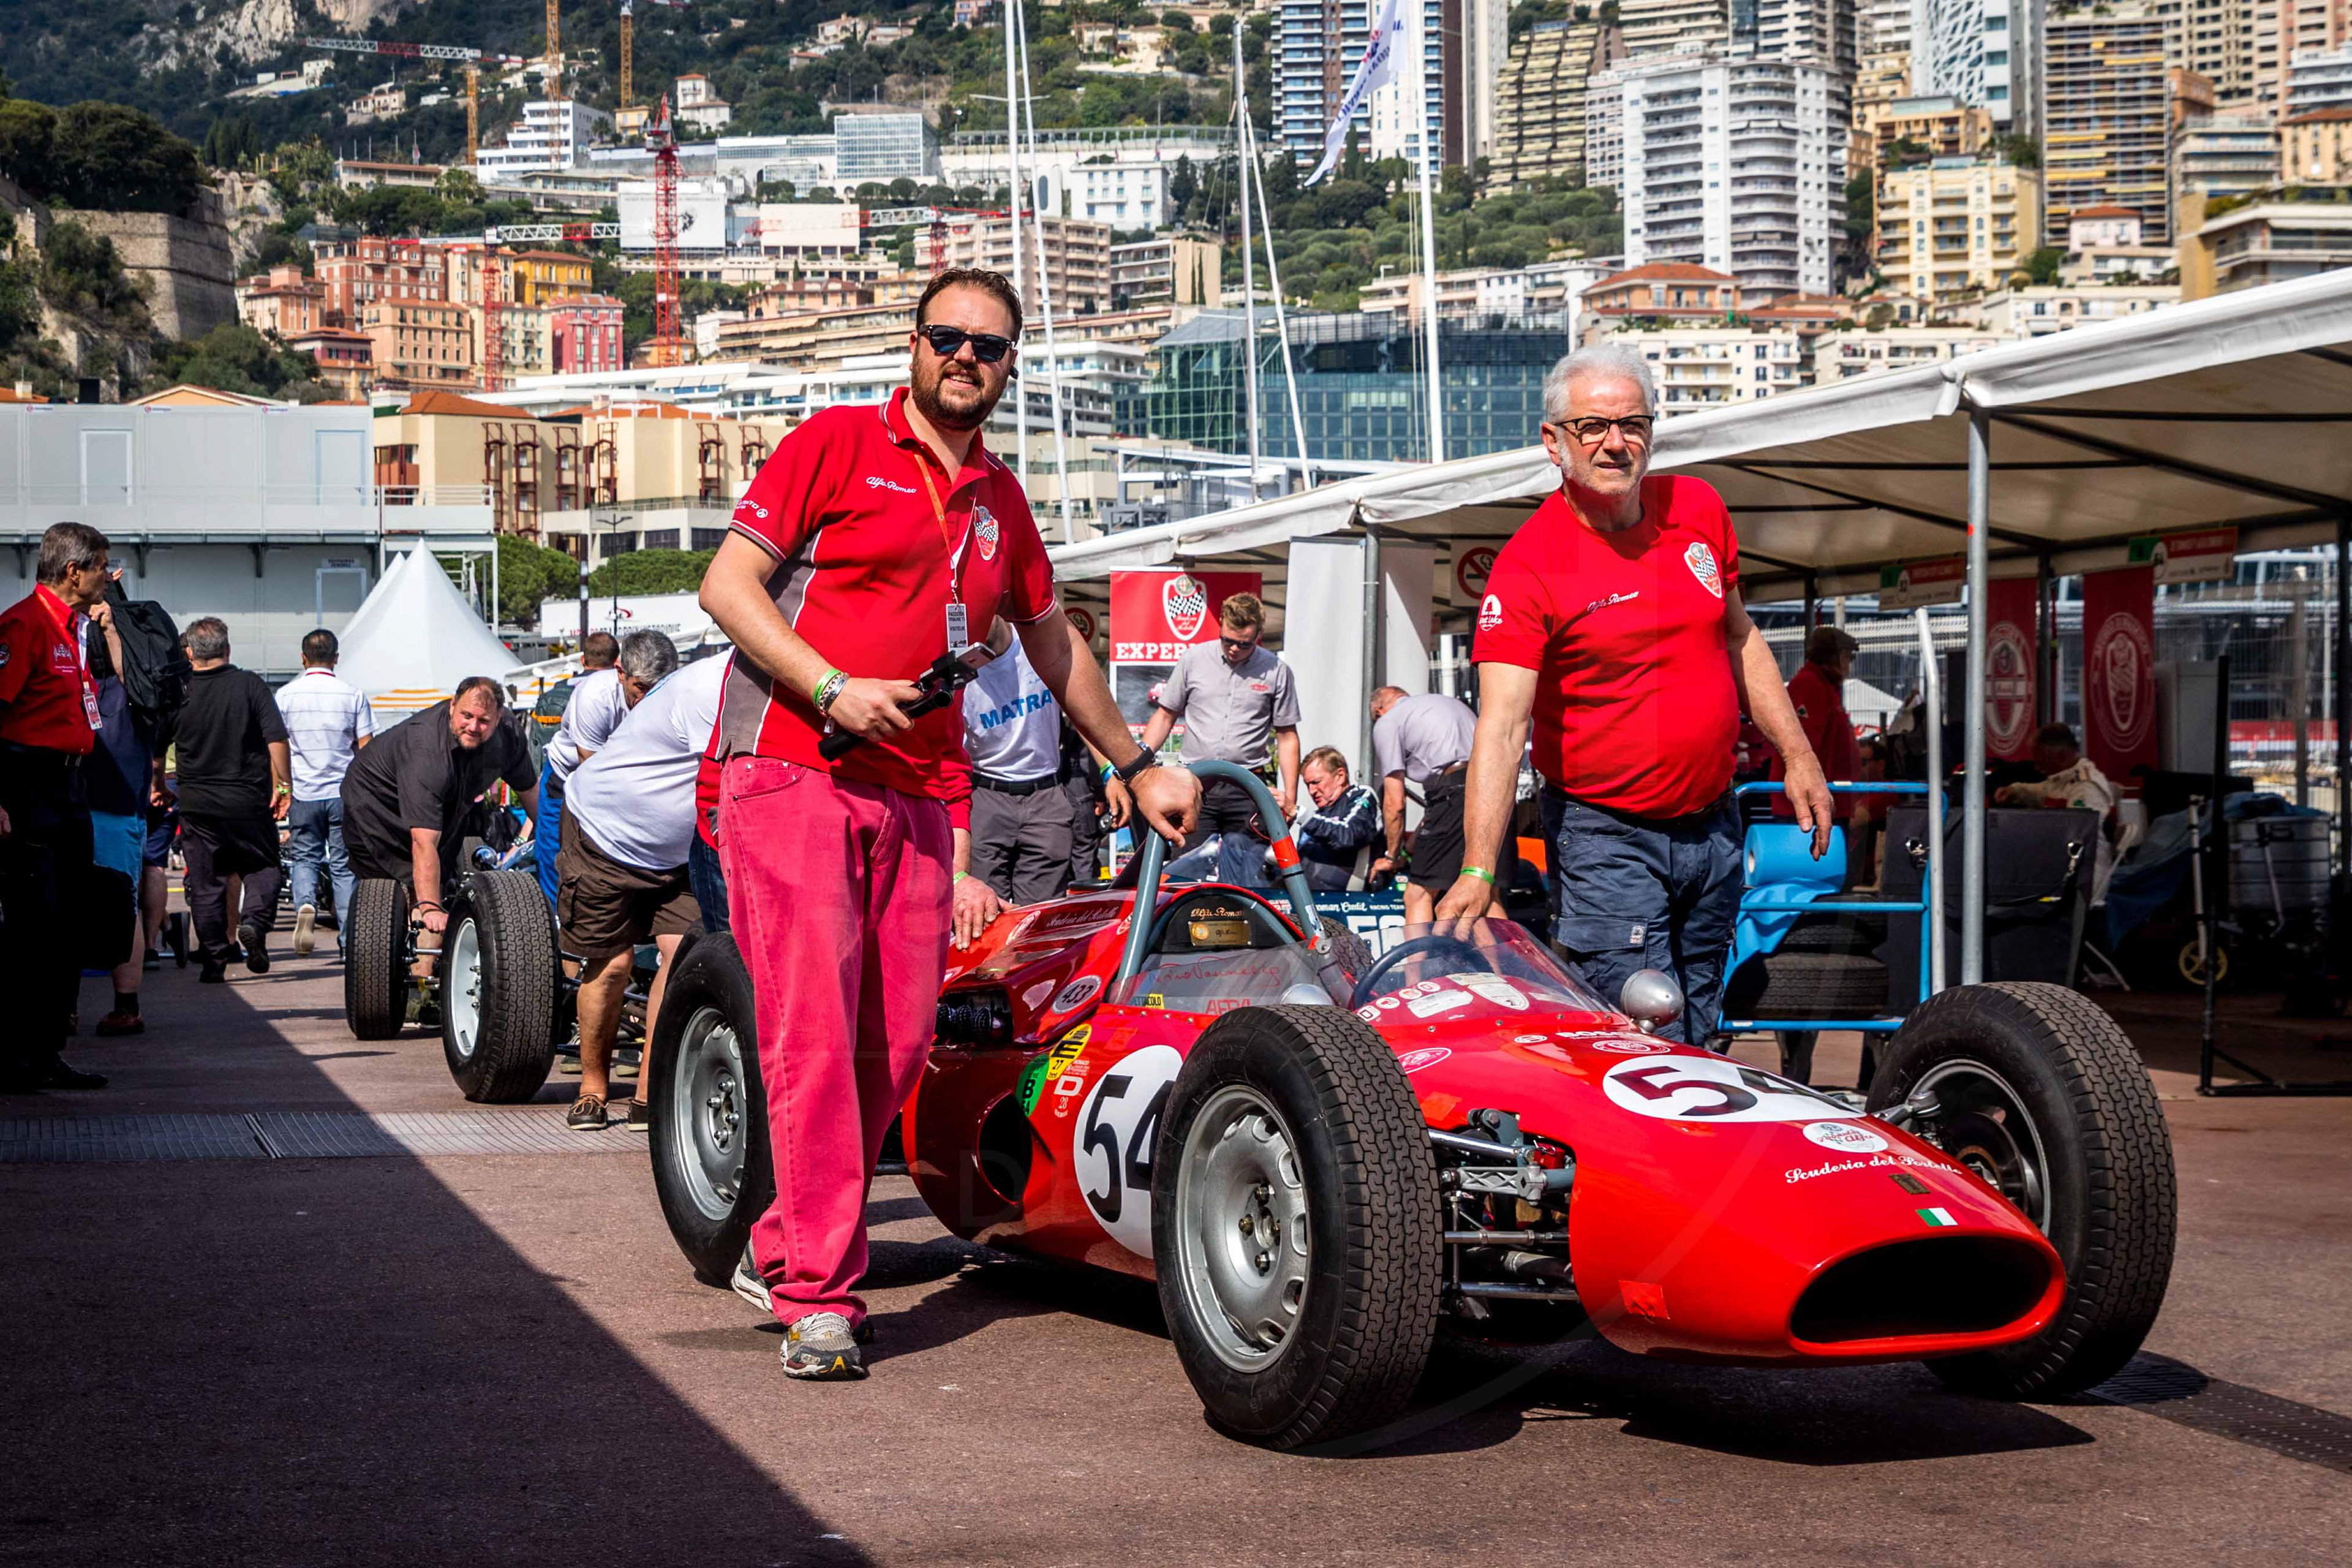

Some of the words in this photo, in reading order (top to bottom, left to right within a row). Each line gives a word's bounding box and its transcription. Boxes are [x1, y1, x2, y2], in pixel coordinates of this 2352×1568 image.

[866, 476, 887, 489] Alfa
[884, 481, 917, 493] Romeo
[1607, 591, 1639, 605] Romeo
[979, 689, 1052, 729] MATRA
[1061, 984, 1094, 1004] 433
[1052, 1040, 1084, 1060] E
[1022, 1079, 1036, 1099] B
[1054, 1075, 1084, 1096] D
[1609, 1066, 1862, 1116] 54
[1058, 1096, 1069, 1109] 28
[1083, 1074, 1176, 1223] 54
[1785, 1159, 1867, 1183] Scuderia
[1869, 1156, 1896, 1167] del
[1896, 1156, 1962, 1175] Portello
